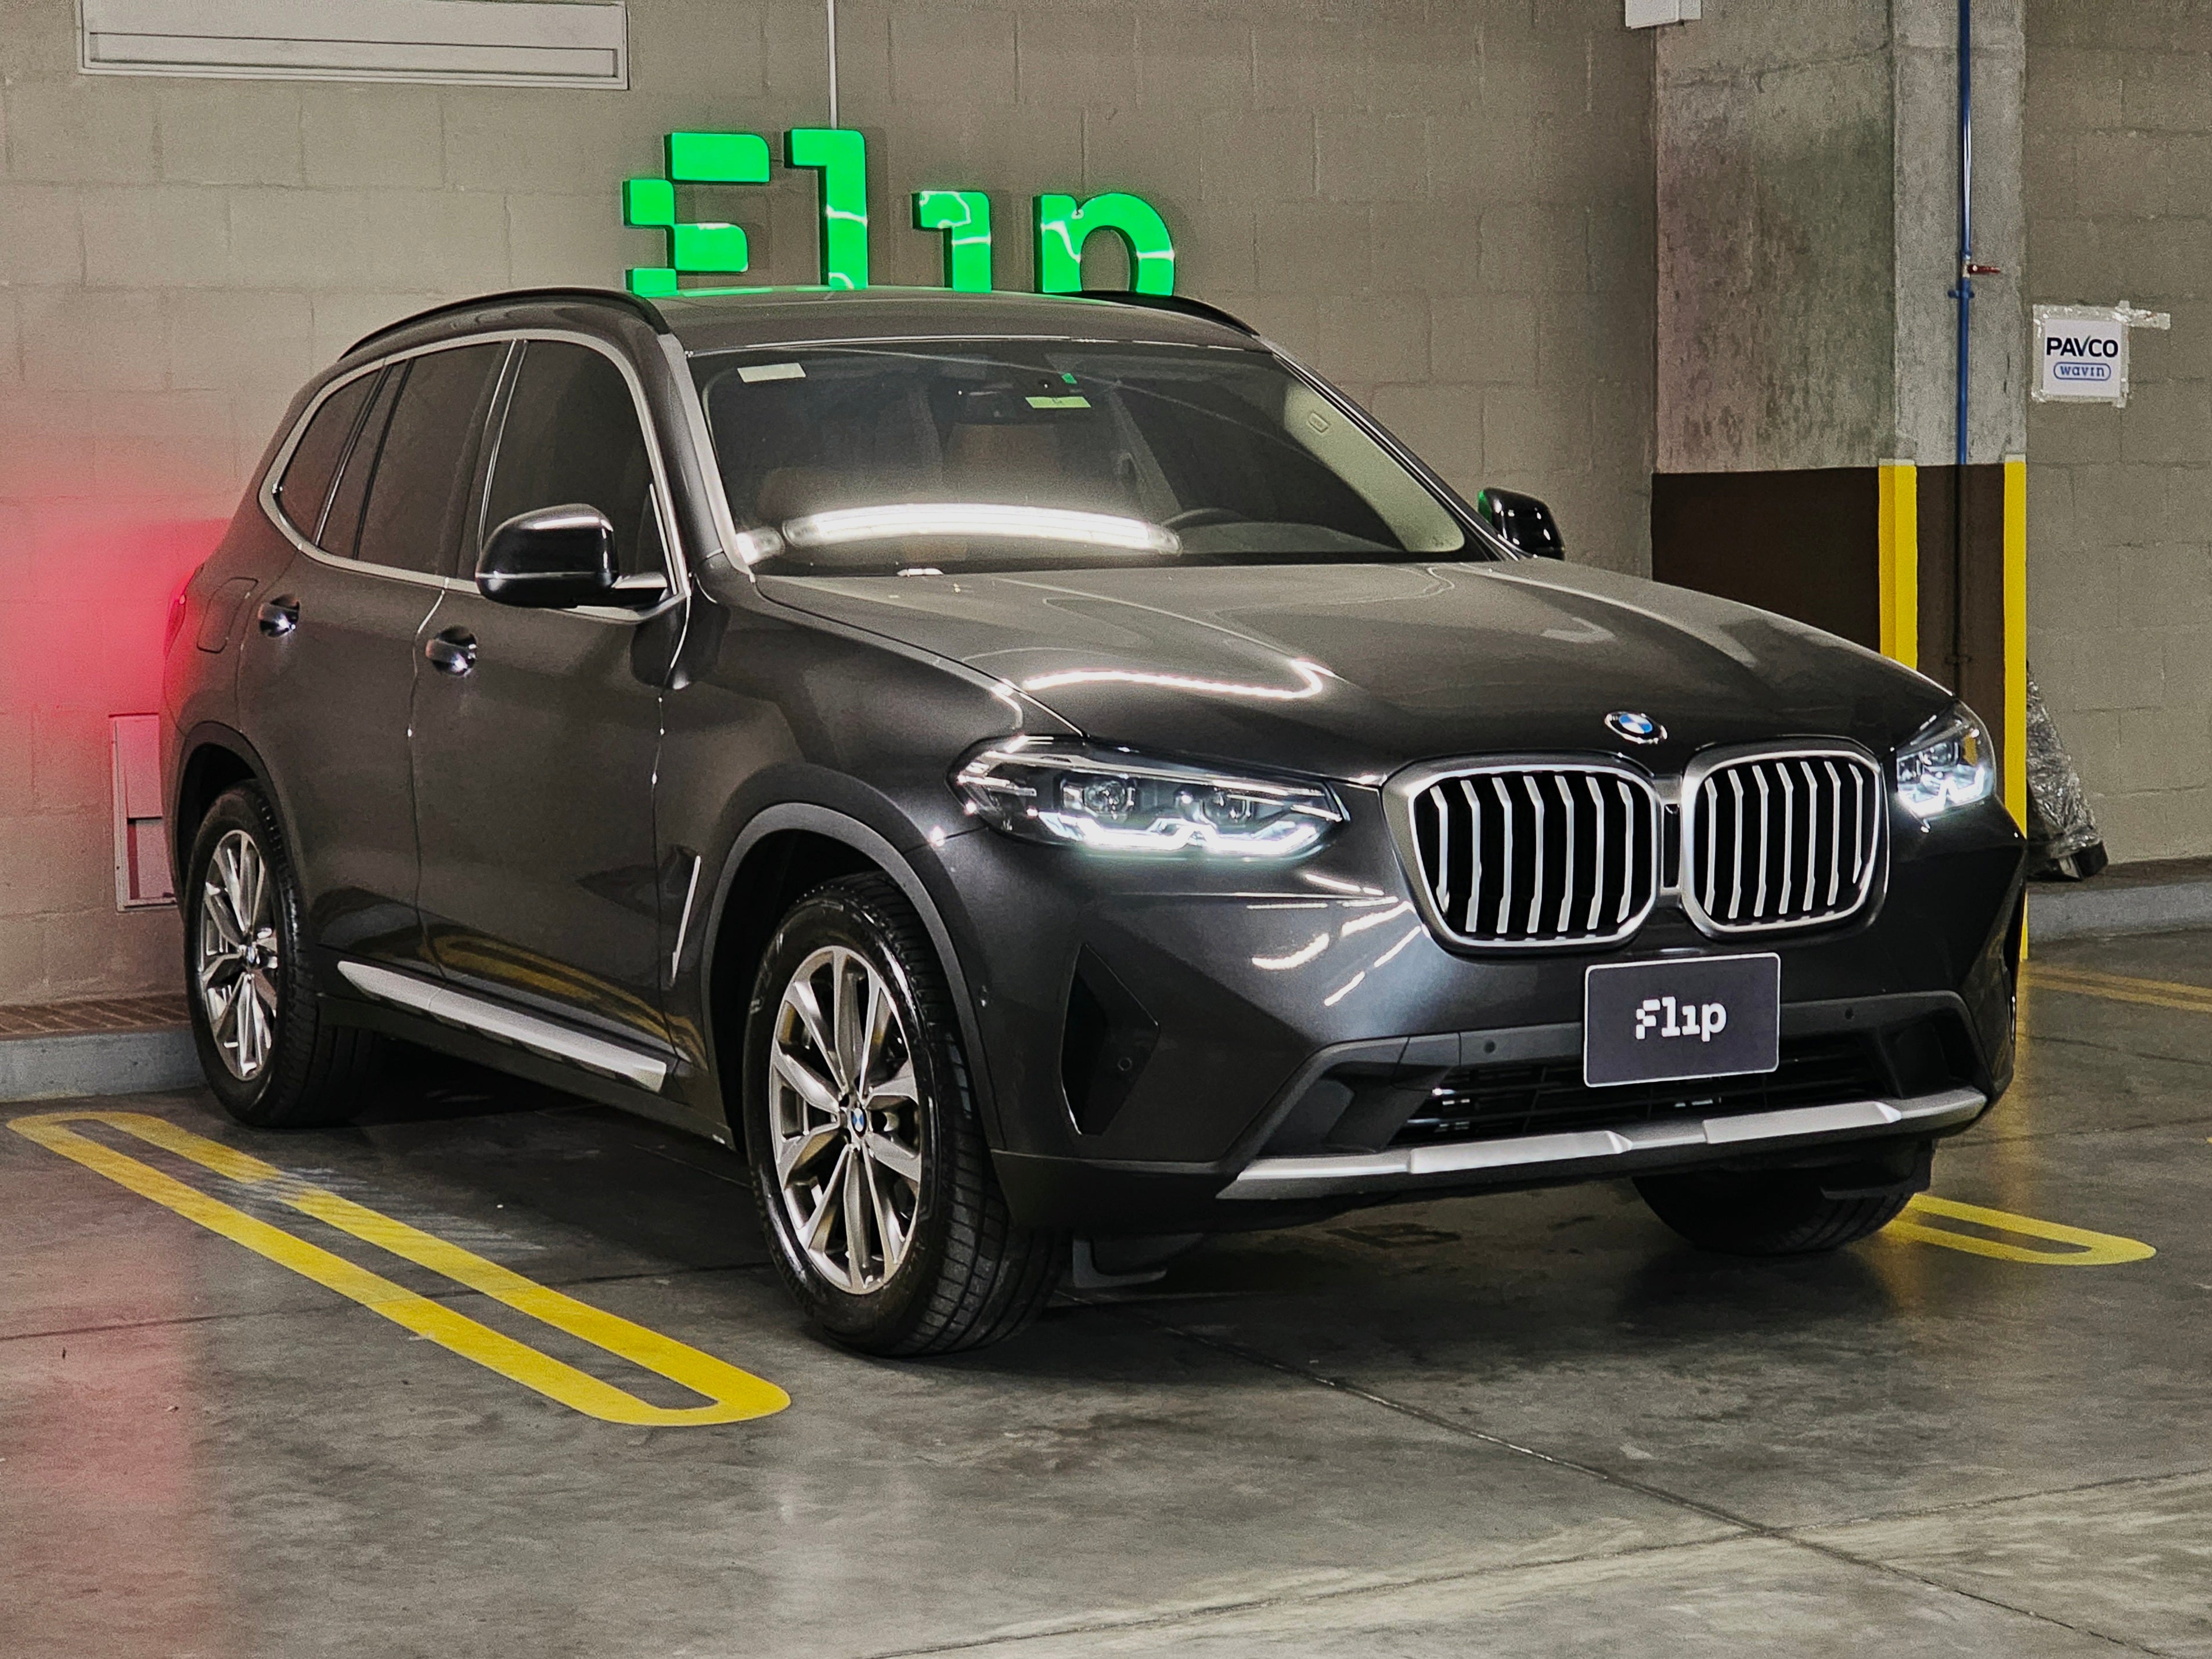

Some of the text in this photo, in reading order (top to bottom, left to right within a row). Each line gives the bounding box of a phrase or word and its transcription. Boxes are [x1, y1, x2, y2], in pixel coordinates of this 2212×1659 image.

[2046, 336, 2119, 358] PAVCO
[2059, 365, 2105, 377] wavin
[1635, 996, 1727, 1043] Flip
